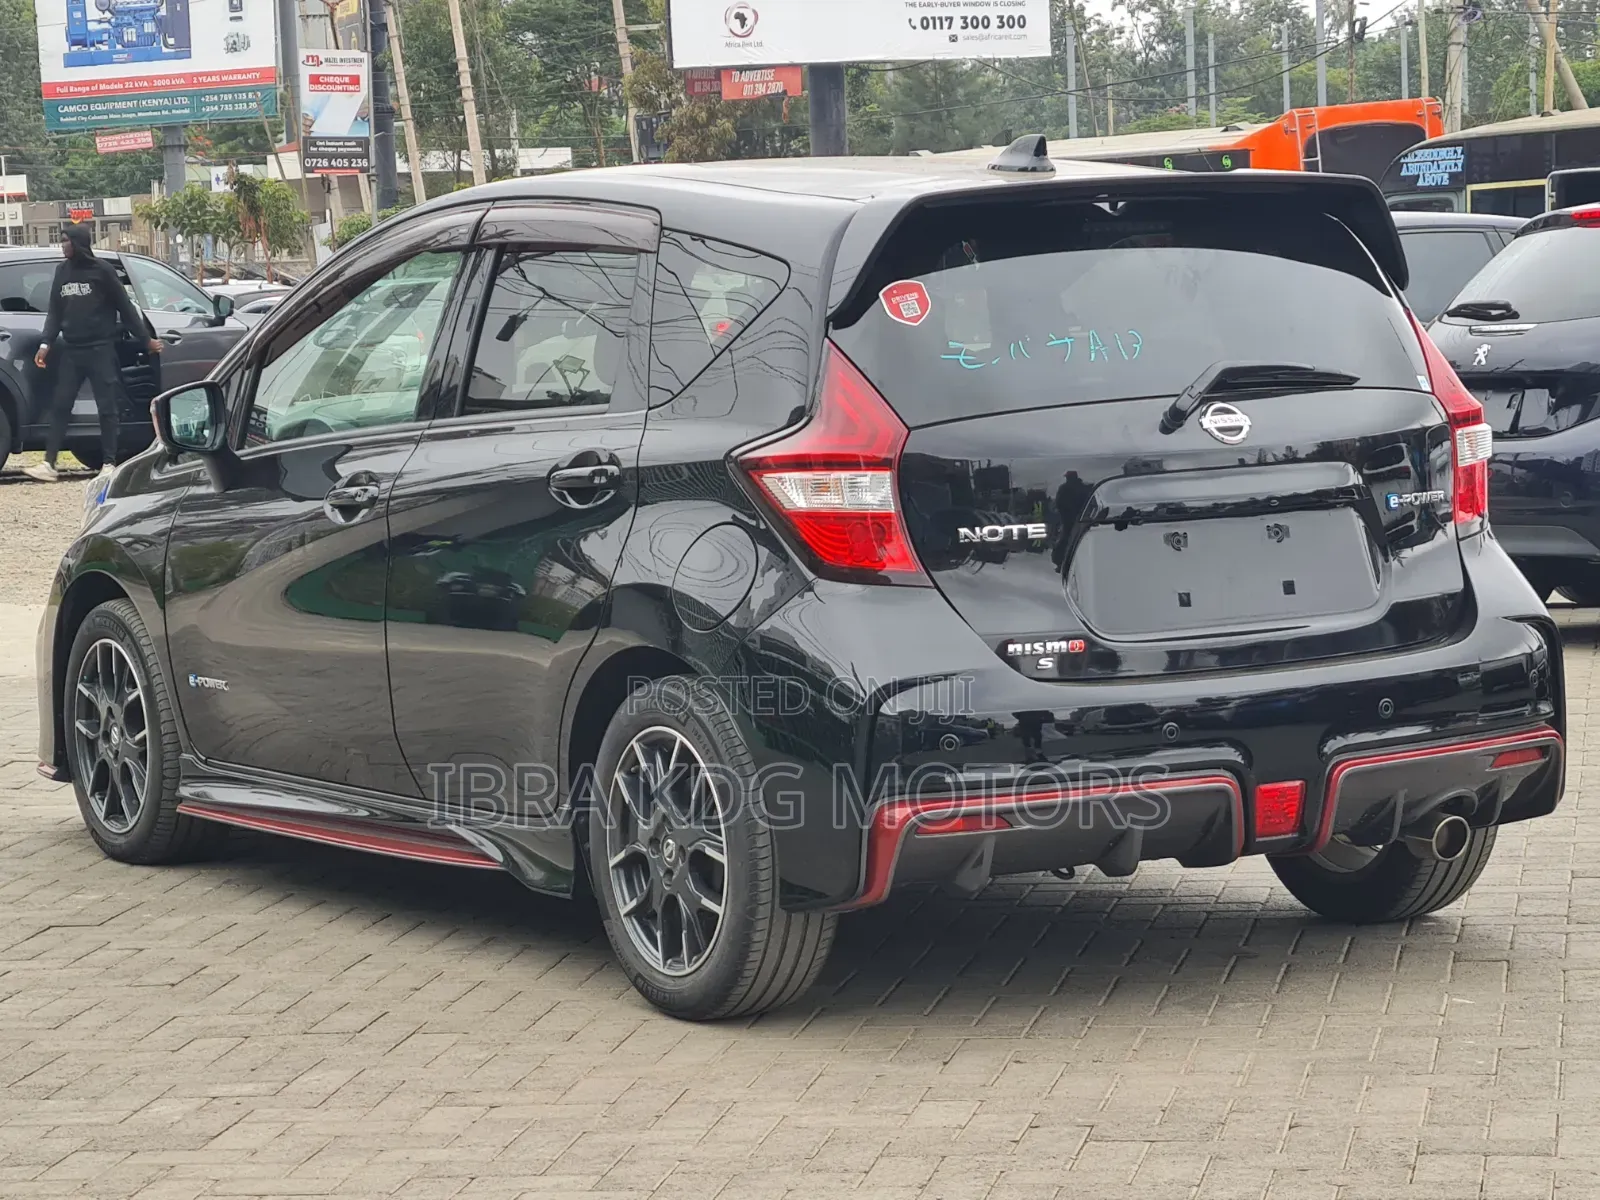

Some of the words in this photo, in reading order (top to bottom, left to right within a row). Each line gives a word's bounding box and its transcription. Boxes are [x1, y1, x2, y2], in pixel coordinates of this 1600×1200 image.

[920, 16, 954, 30] 0117
[960, 15, 990, 30] 300
[996, 14, 1026, 29] 300
[69, 85, 90, 93] Range
[100, 82, 123, 90] Models
[124, 81, 133, 89] 22
[135, 80, 148, 88] kVA
[171, 77, 185, 85] kVA
[198, 75, 220, 83] YEARS
[221, 72, 260, 81] WARRANTY
[319, 76, 350, 84] CHEQUE
[731, 71, 740, 83] TO
[740, 69, 776, 82] ADVERTISE
[767, 81, 784, 94] 2870
[58, 104, 89, 113] CAMCO
[90, 100, 137, 111] EQUIPMENT
[139, 97, 172, 108] (KENYA)
[173, 96, 190, 105] LTD.
[201, 94, 218, 102] +254
[304, 158, 329, 167] 0726
[330, 158, 349, 167] 405
[351, 158, 368, 167] 236
[1400, 160, 1463, 176] ABUNDANTLY
[1417, 173, 1450, 186] ABOVE
[1209, 416, 1247, 425] NISSAN
[1386, 490, 1445, 508] e-POWER
[957, 523, 1047, 543] NOTE
[1037, 657, 1054, 669] S
